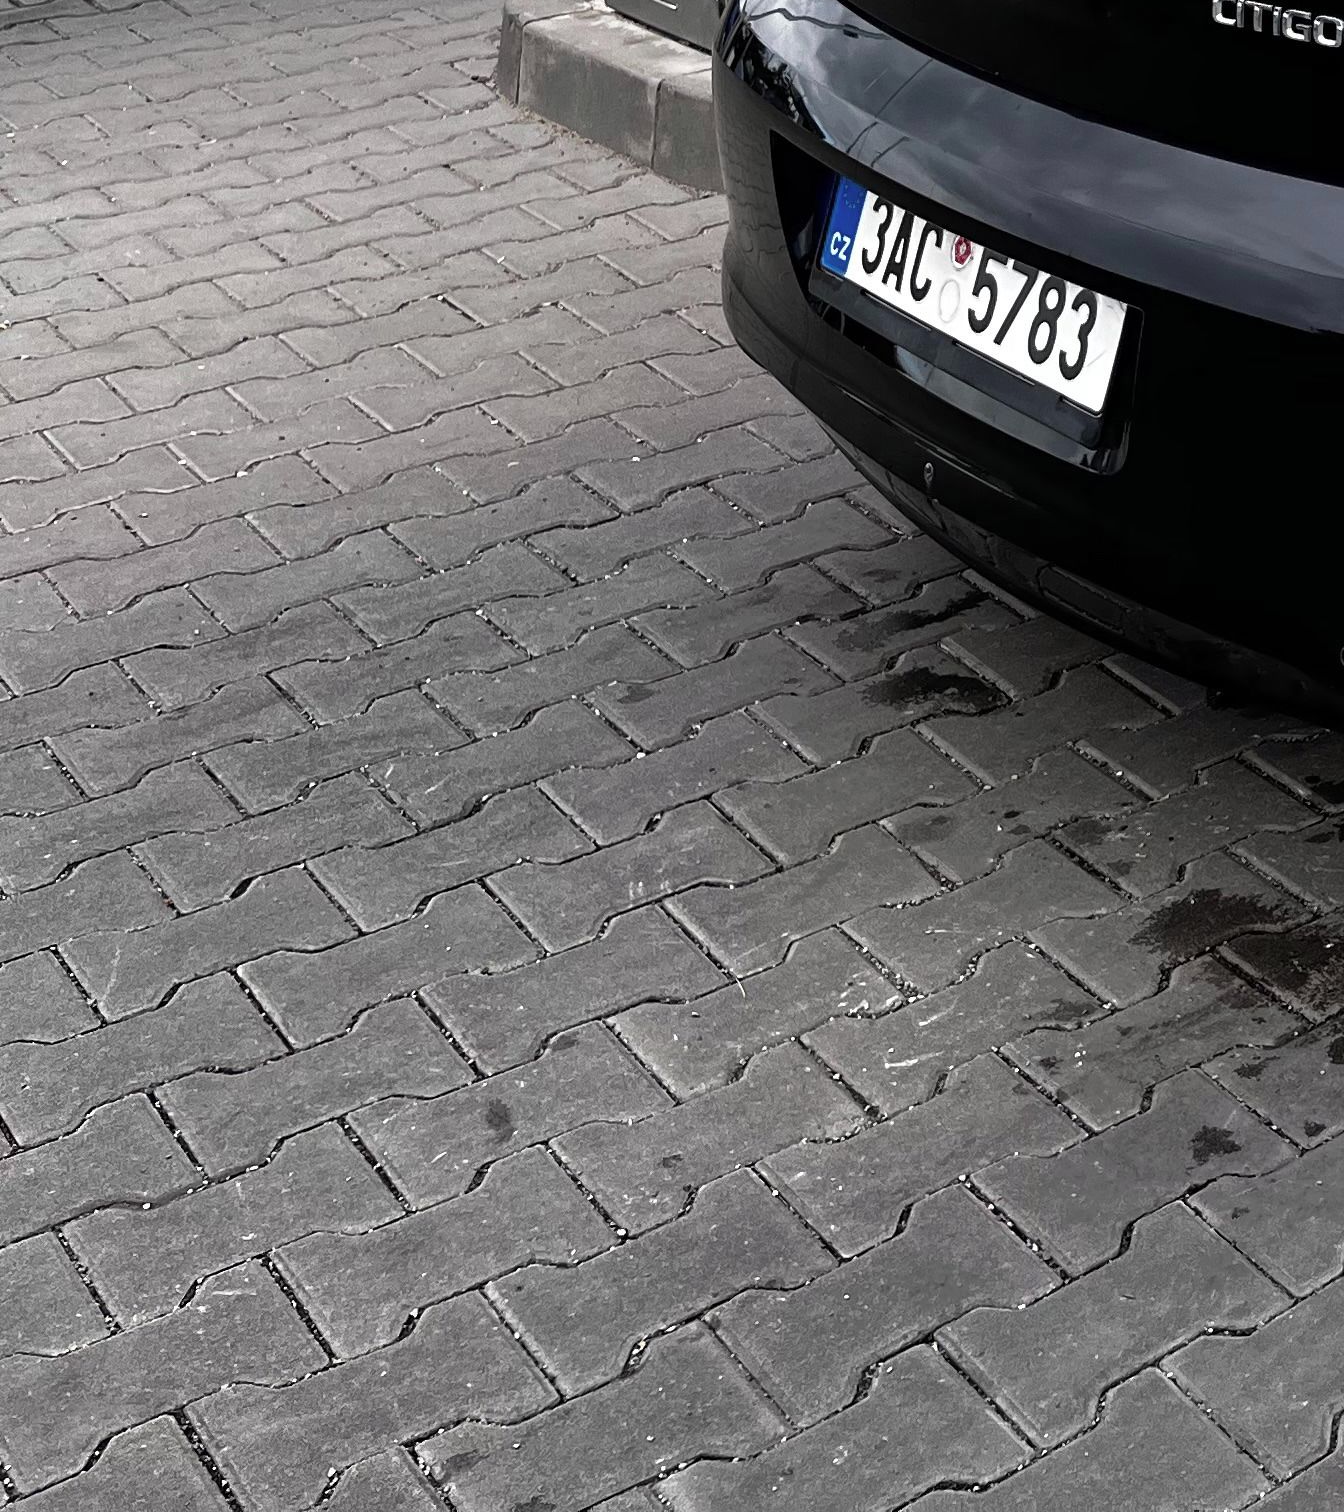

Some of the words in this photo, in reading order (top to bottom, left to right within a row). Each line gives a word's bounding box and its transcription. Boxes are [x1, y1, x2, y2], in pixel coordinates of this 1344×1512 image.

[829, 231, 851, 261] CZ
[861, 195, 944, 302] 3AC
[967, 247, 1098, 381] 5783
